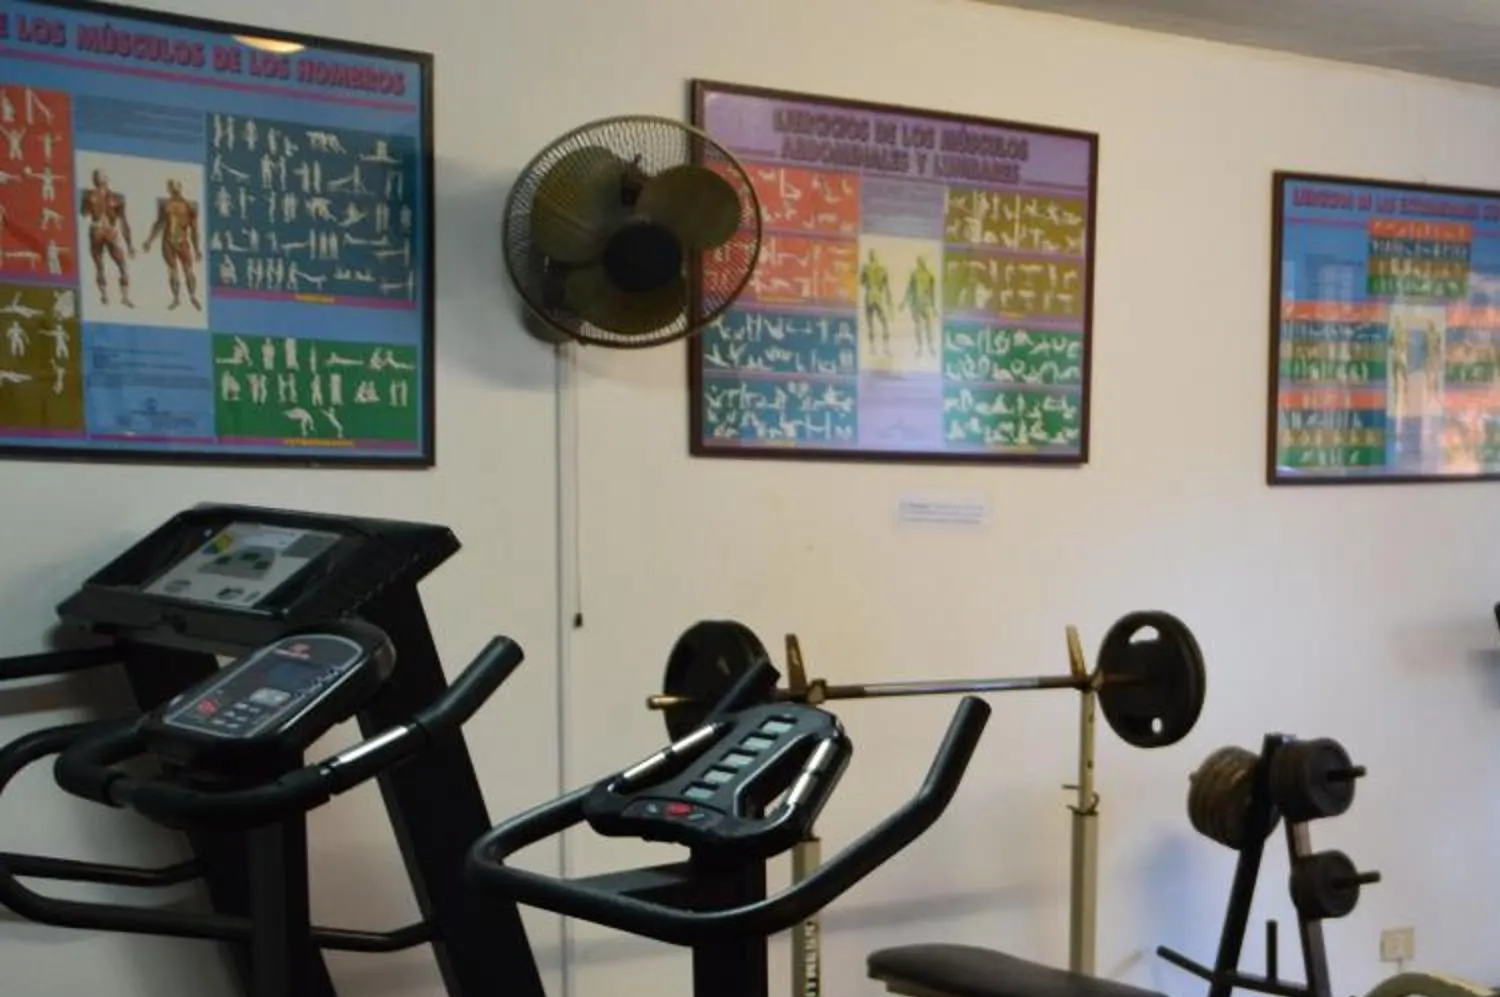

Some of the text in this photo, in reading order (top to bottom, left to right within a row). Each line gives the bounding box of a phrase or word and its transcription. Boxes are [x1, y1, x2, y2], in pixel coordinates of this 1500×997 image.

[18, 17, 66, 47] LOS
[213, 49, 242, 75] DE
[250, 52, 290, 81] LOS
